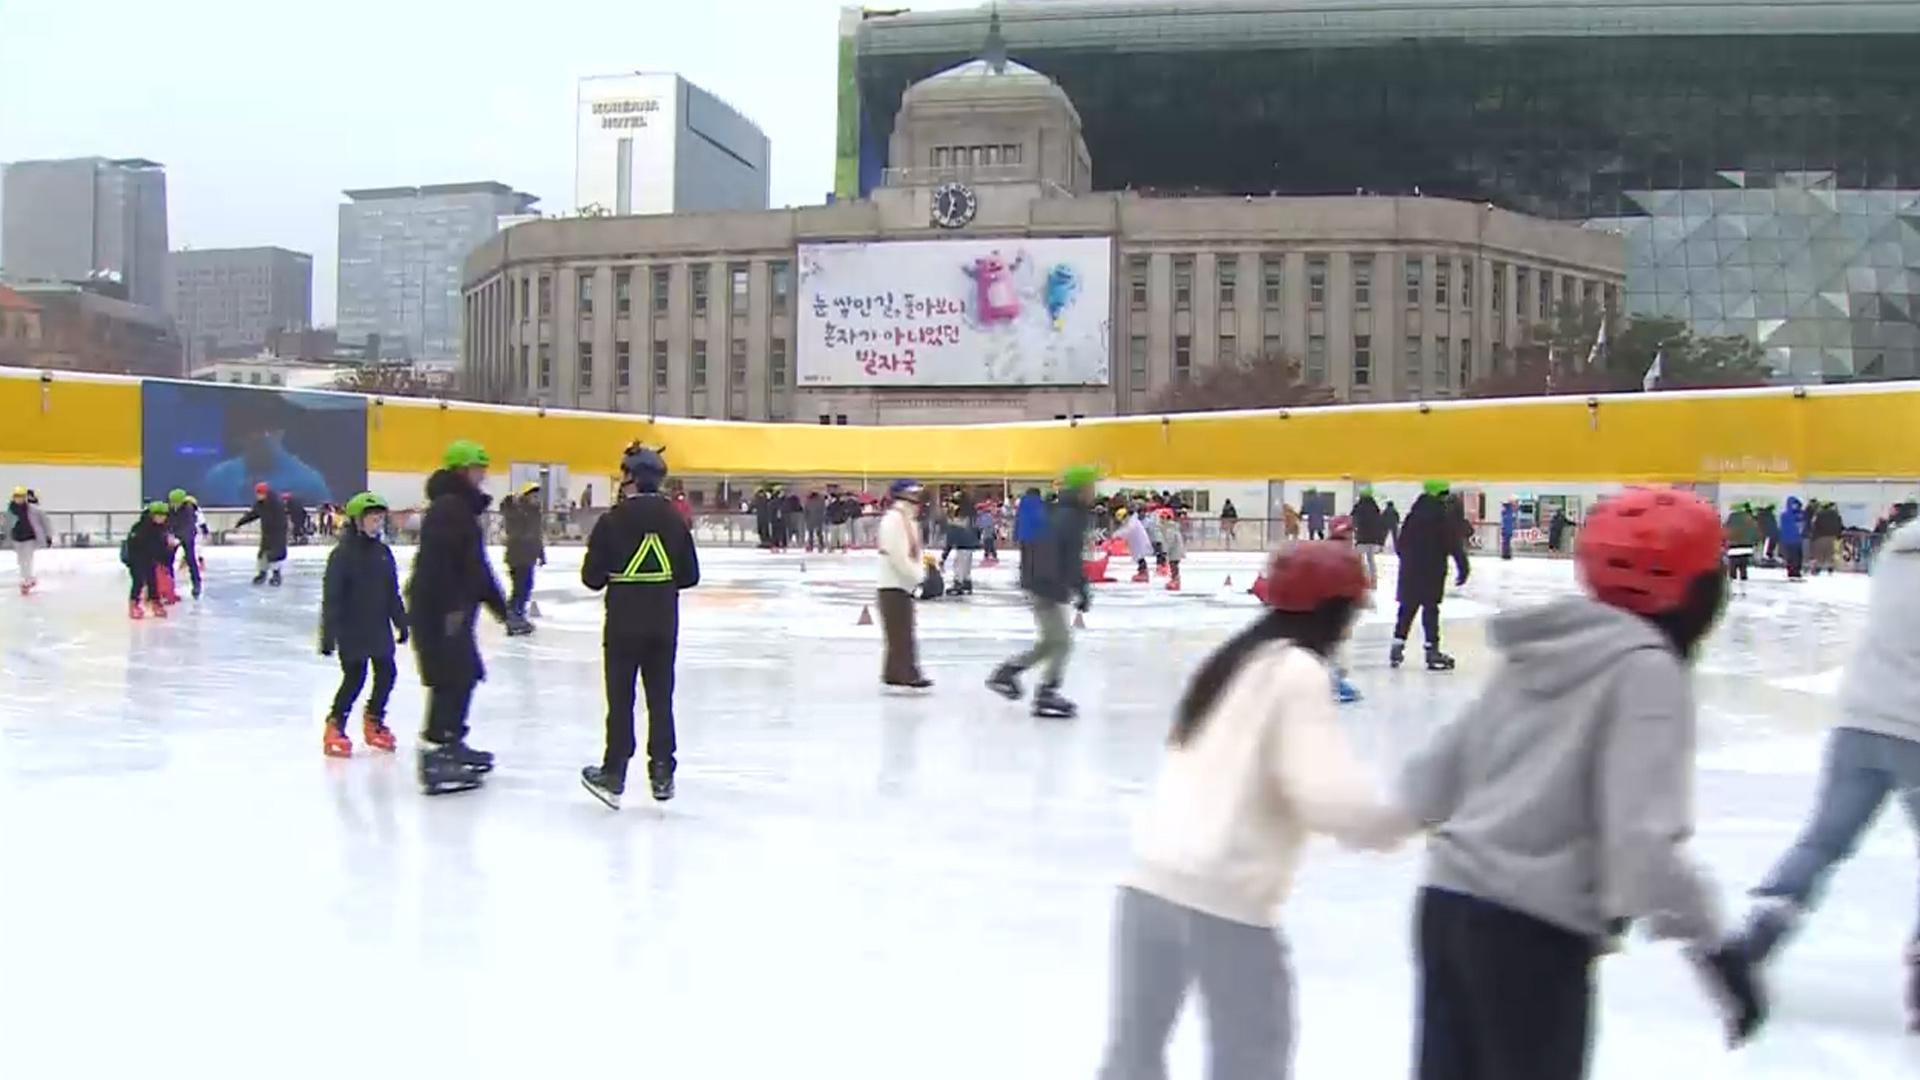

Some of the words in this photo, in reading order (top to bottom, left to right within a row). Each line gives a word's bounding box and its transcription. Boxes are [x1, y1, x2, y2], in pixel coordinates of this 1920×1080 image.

[601, 115, 648, 129] HOTEL
[812, 292, 829, 318] 눈
[904, 293, 966, 320] 돌아보니
[824, 320, 878, 348] 혼자가
[883, 324, 960, 347] 아니었던
[855, 349, 917, 376] 발자국
